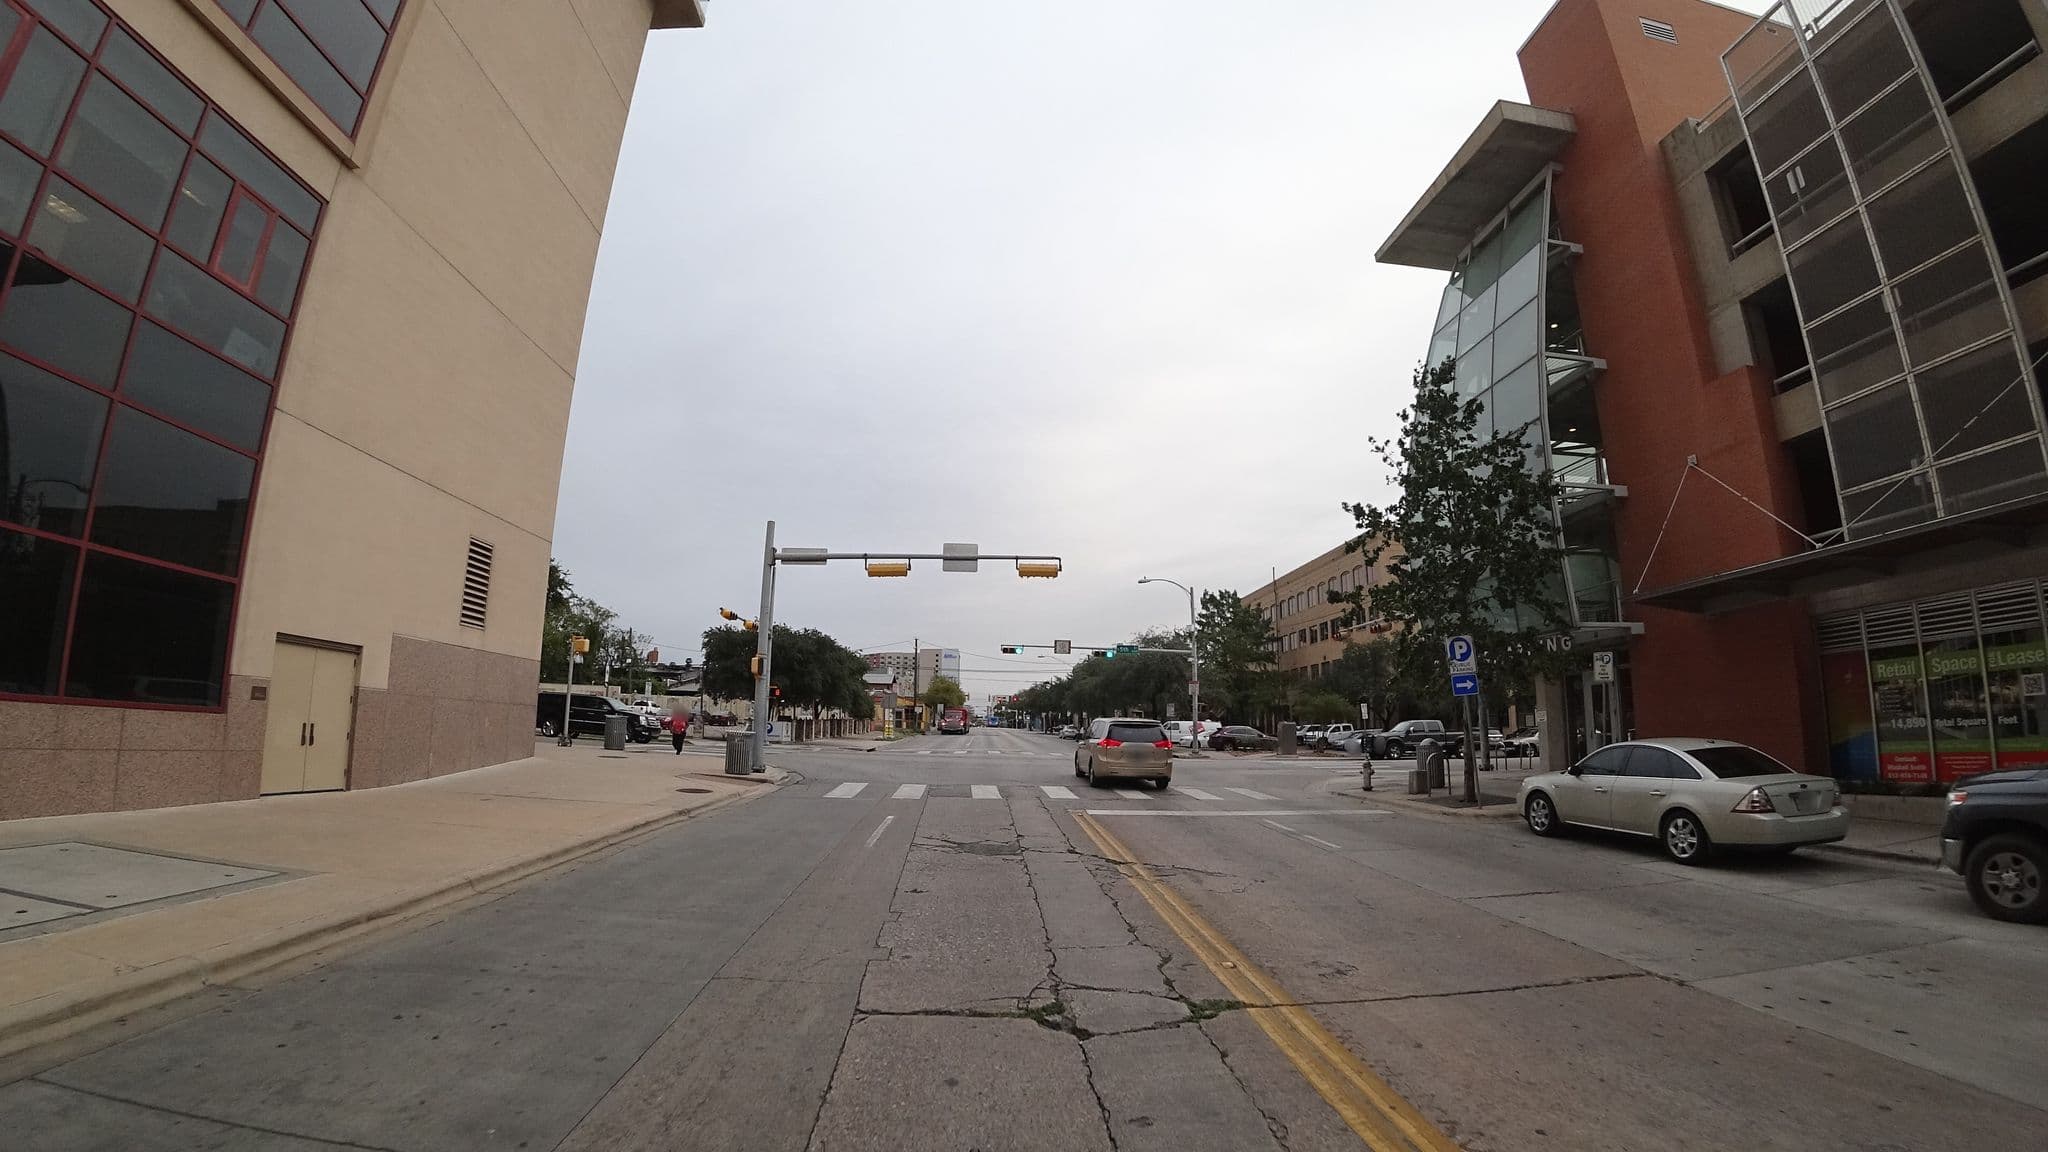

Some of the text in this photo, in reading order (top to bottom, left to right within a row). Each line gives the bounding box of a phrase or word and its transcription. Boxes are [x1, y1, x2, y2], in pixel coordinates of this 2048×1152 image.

[1454, 640, 1467, 660] P
[1543, 635, 1572, 652] NG
[1877, 661, 1917, 679] Retail
[1931, 656, 1978, 674] Space
[1997, 649, 2046, 666] Lease
[1935, 718, 1955, 728] Total
[1956, 717, 1987, 728] Square
[1998, 715, 2018, 725] Feet
